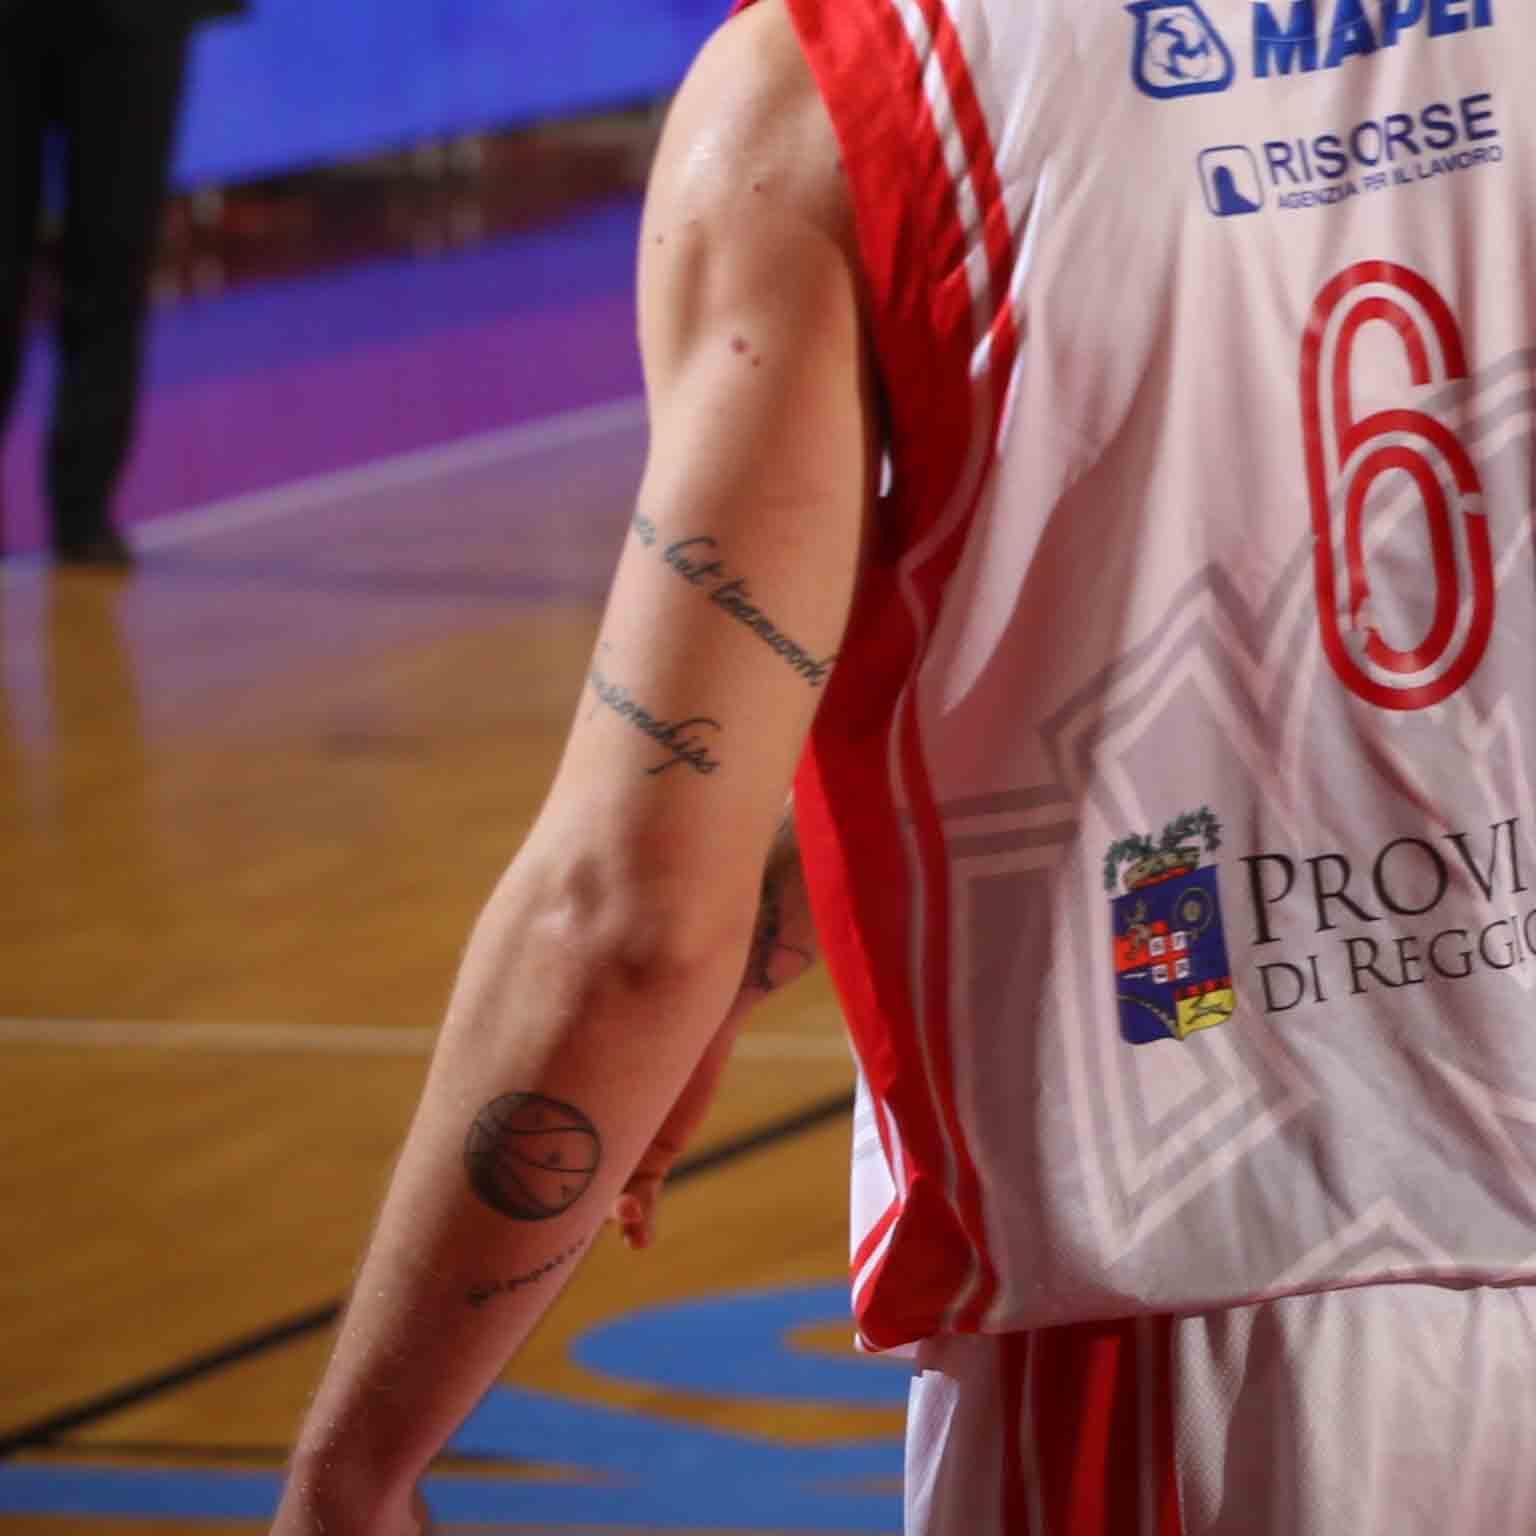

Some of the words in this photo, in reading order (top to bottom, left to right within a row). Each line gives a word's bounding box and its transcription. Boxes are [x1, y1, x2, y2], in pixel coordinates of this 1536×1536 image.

[1263, 93, 1499, 185] RISORSE
[1417, 145, 1501, 180] LAVORO
[1301, 260, 1494, 710] 6
[1257, 955, 1328, 1014] DI
